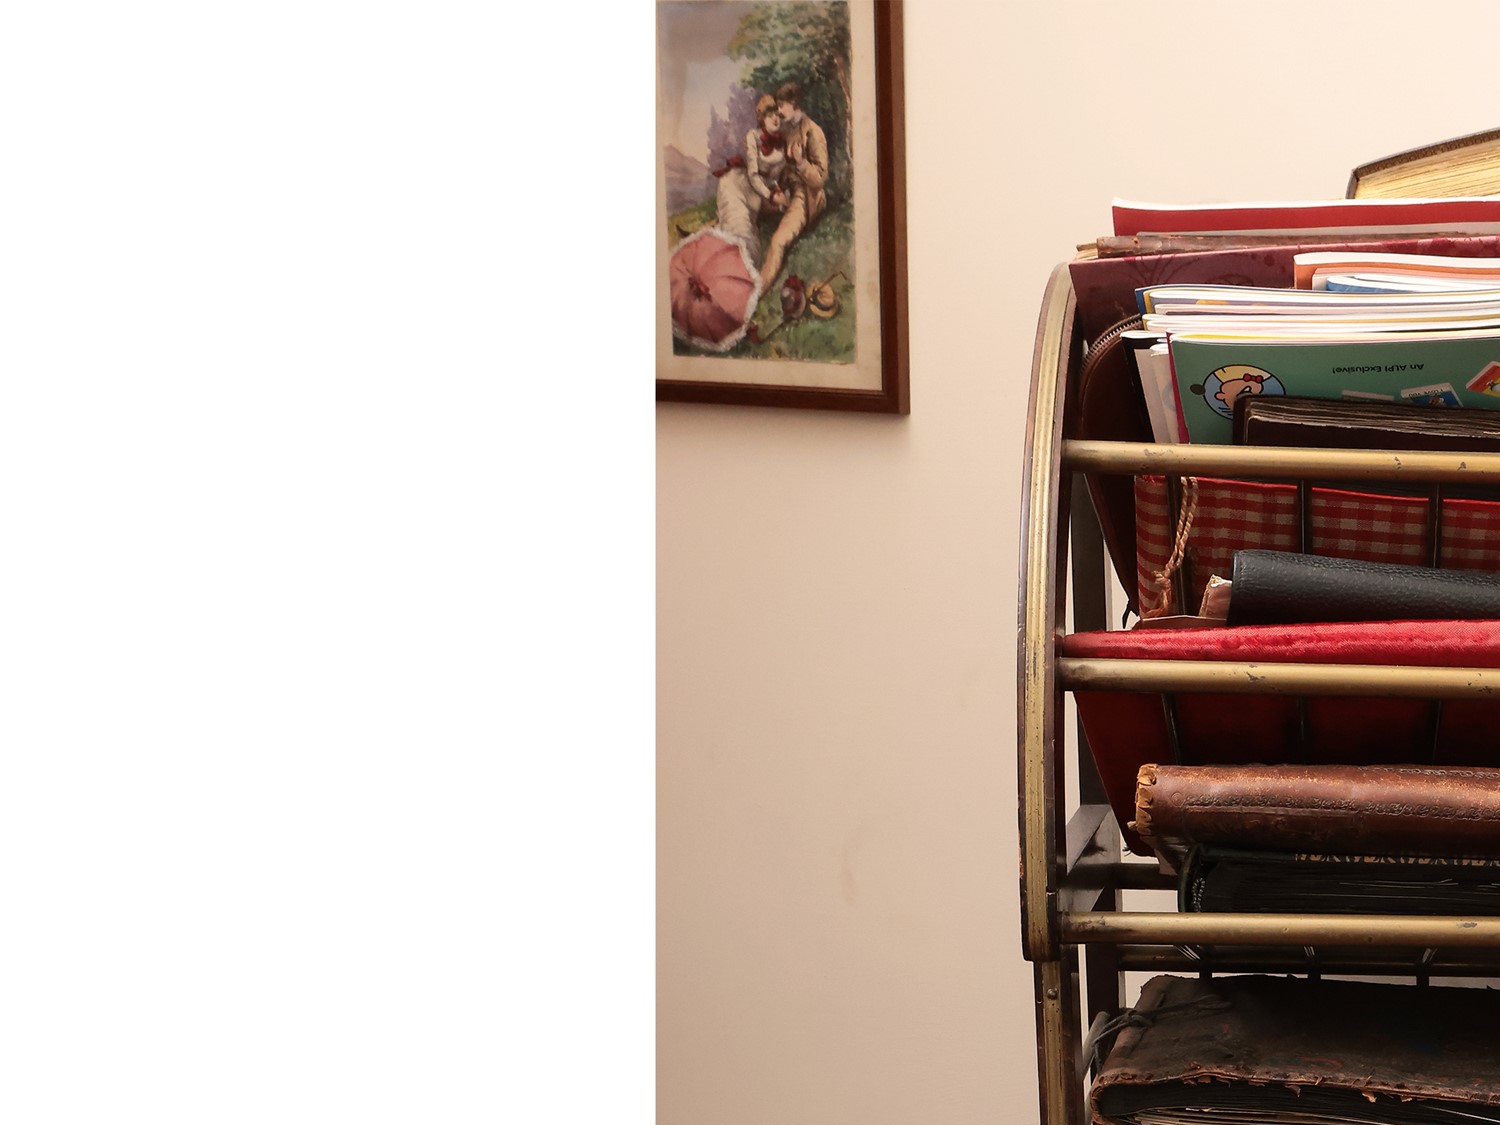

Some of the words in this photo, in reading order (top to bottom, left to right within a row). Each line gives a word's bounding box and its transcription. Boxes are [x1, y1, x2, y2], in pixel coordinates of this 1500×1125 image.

[1332, 365, 1382, 375] Exclusive!
[1385, 364, 1407, 372] ALPI
[1410, 363, 1425, 371] An
